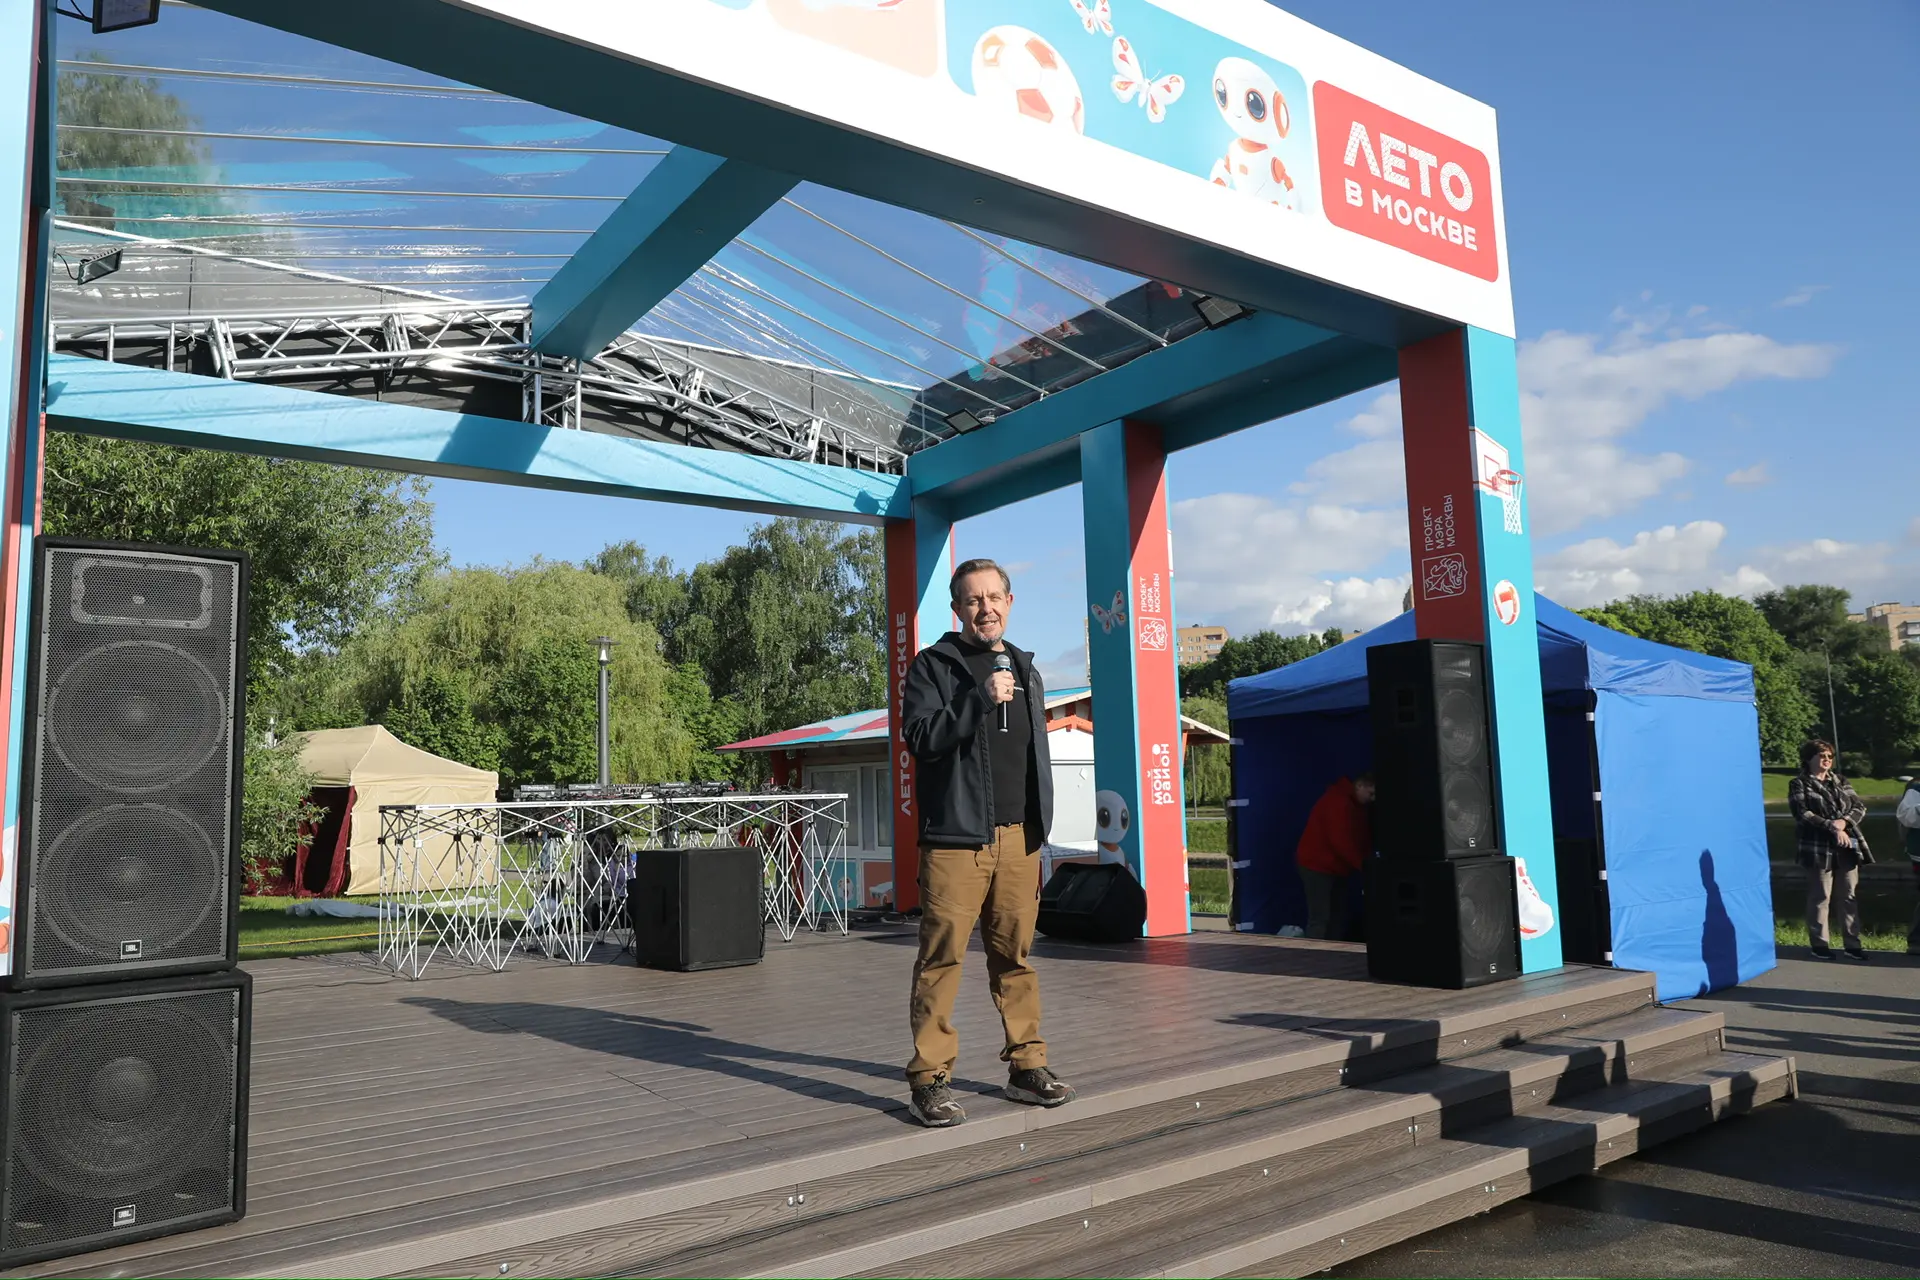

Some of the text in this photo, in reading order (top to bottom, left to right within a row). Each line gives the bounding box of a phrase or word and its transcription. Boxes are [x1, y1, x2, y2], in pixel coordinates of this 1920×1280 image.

[1344, 120, 1473, 212] ЛЕТО
[1344, 178, 1478, 251] В МОСКВЕ
[1422, 506, 1434, 552] ПРОЕКТ
[1434, 515, 1445, 549] МЭРА
[1443, 494, 1456, 547] МОСКВЫ
[1153, 573, 1161, 613] МОСКВЫ
[900, 750, 911, 817] ЛЕТО
[1160, 744, 1175, 804] район
